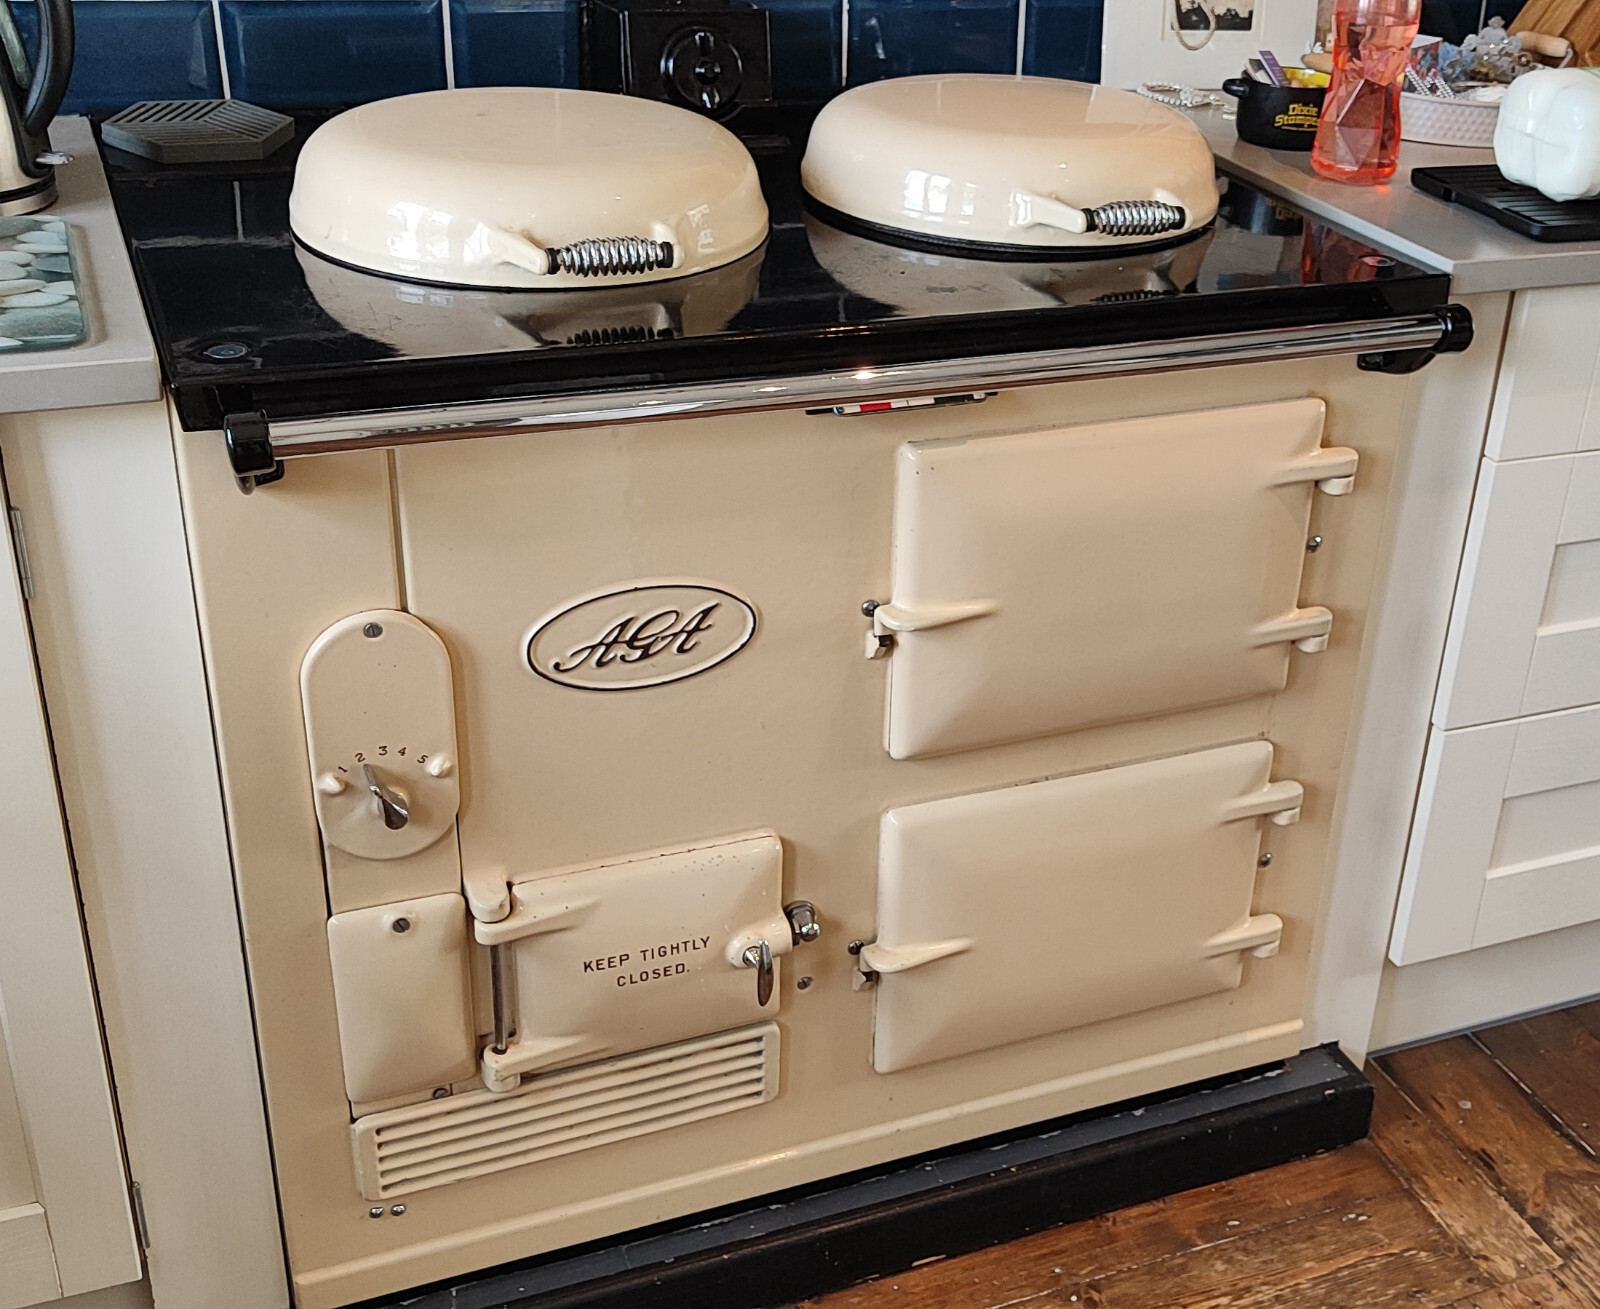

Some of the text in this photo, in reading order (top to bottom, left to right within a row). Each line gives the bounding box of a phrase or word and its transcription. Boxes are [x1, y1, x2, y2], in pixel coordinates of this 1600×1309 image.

[1274, 114, 1320, 128] Stampe
[1288, 103, 1318, 116] Dixie
[553, 602, 720, 673] AGA
[338, 745, 428, 774] 1 2 3 4 5
[583, 936, 710, 973] KEEP TIGHTLY
[616, 963, 690, 987] CLOSED.
